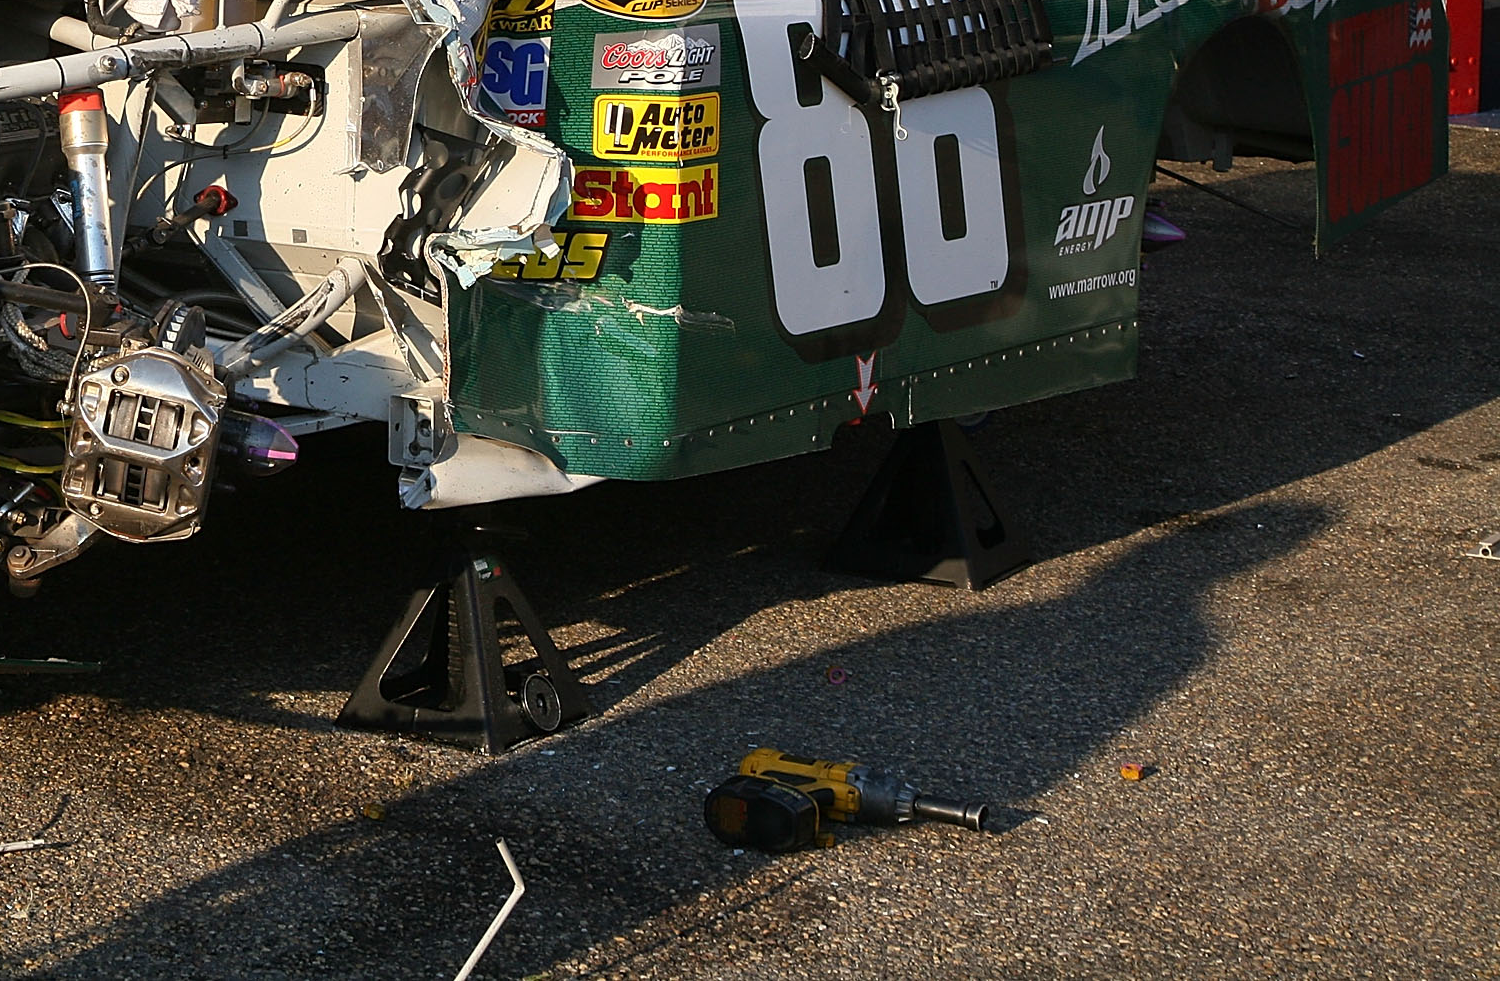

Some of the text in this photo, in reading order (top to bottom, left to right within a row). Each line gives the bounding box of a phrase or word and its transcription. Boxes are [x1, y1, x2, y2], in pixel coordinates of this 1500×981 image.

[631, 0, 663, 13] CUP
[601, 42, 715, 70] Coors LIGHT
[617, 69, 704, 84] POLE
[639, 102, 706, 126] Auto
[630, 124, 715, 151] Meter
[640, 148, 692, 157] PERFORMANCE
[573, 168, 717, 220] Stant
[1058, 240, 1094, 257] ENERGY
[1049, 268, 1136, 300] www.marrow.org
